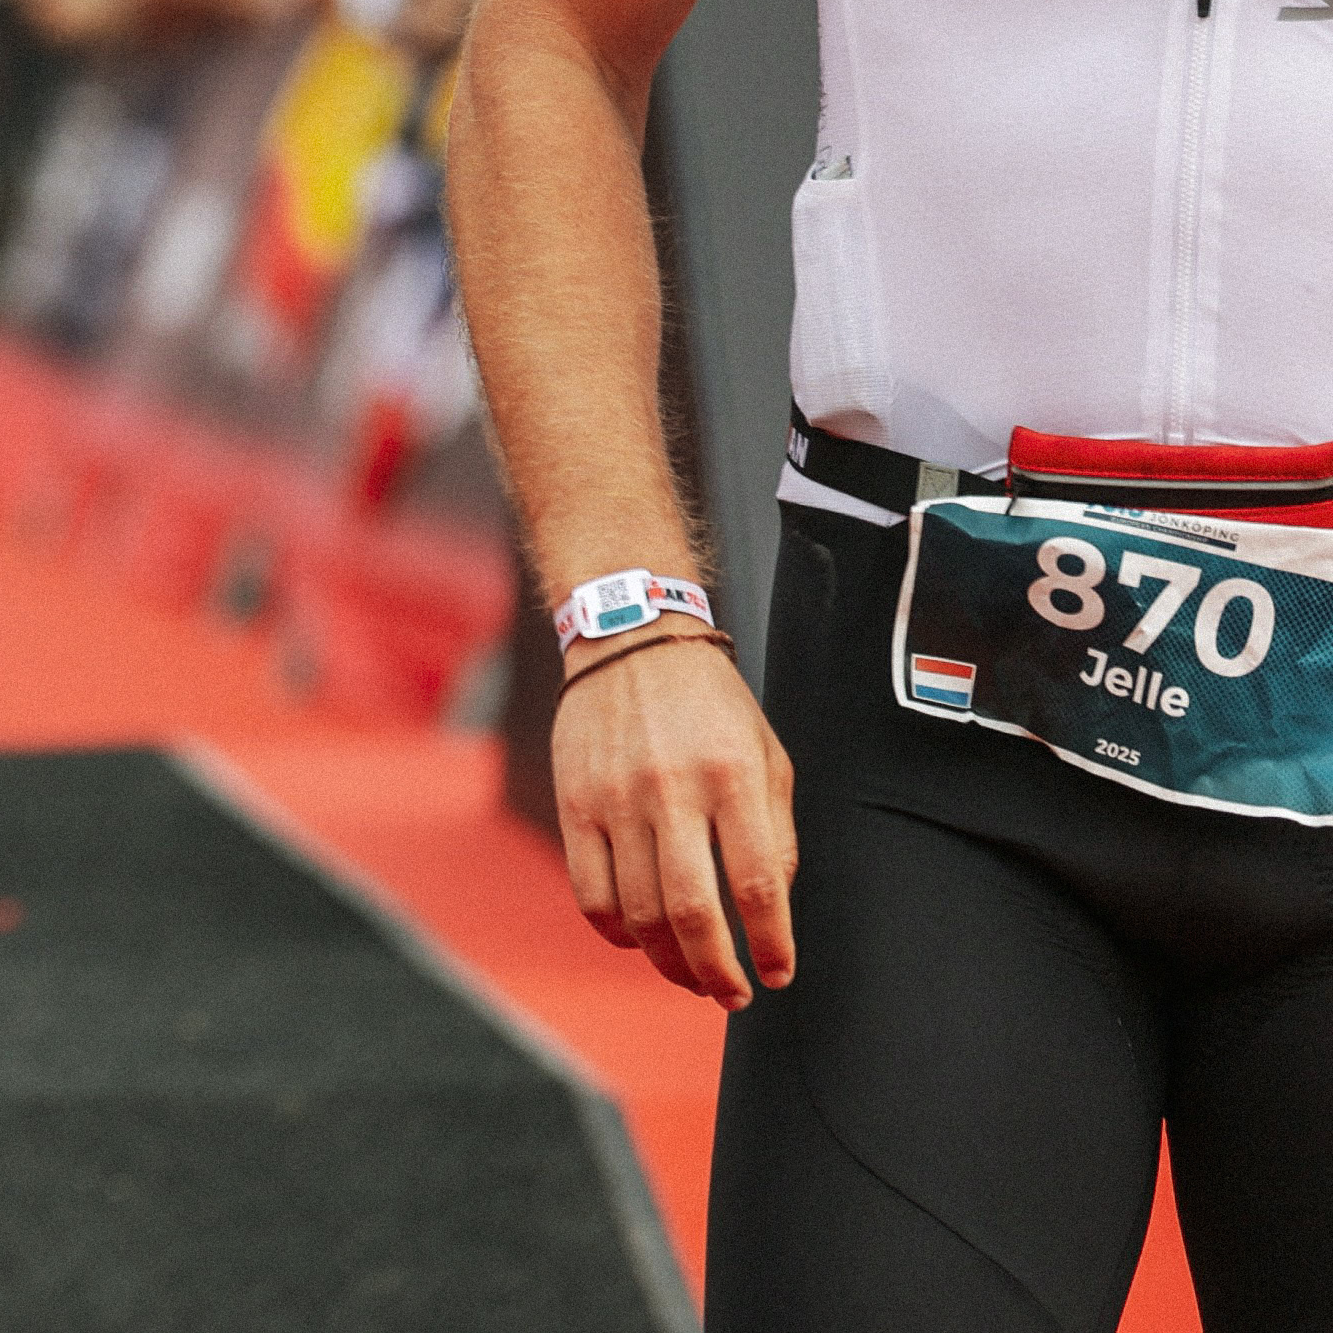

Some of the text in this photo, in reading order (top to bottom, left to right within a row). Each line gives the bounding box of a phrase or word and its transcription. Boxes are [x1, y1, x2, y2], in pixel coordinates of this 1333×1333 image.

[1027, 536, 1276, 678] 870
[1079, 647, 1190, 717] Jelle
[1094, 738, 1142, 766] 2025
